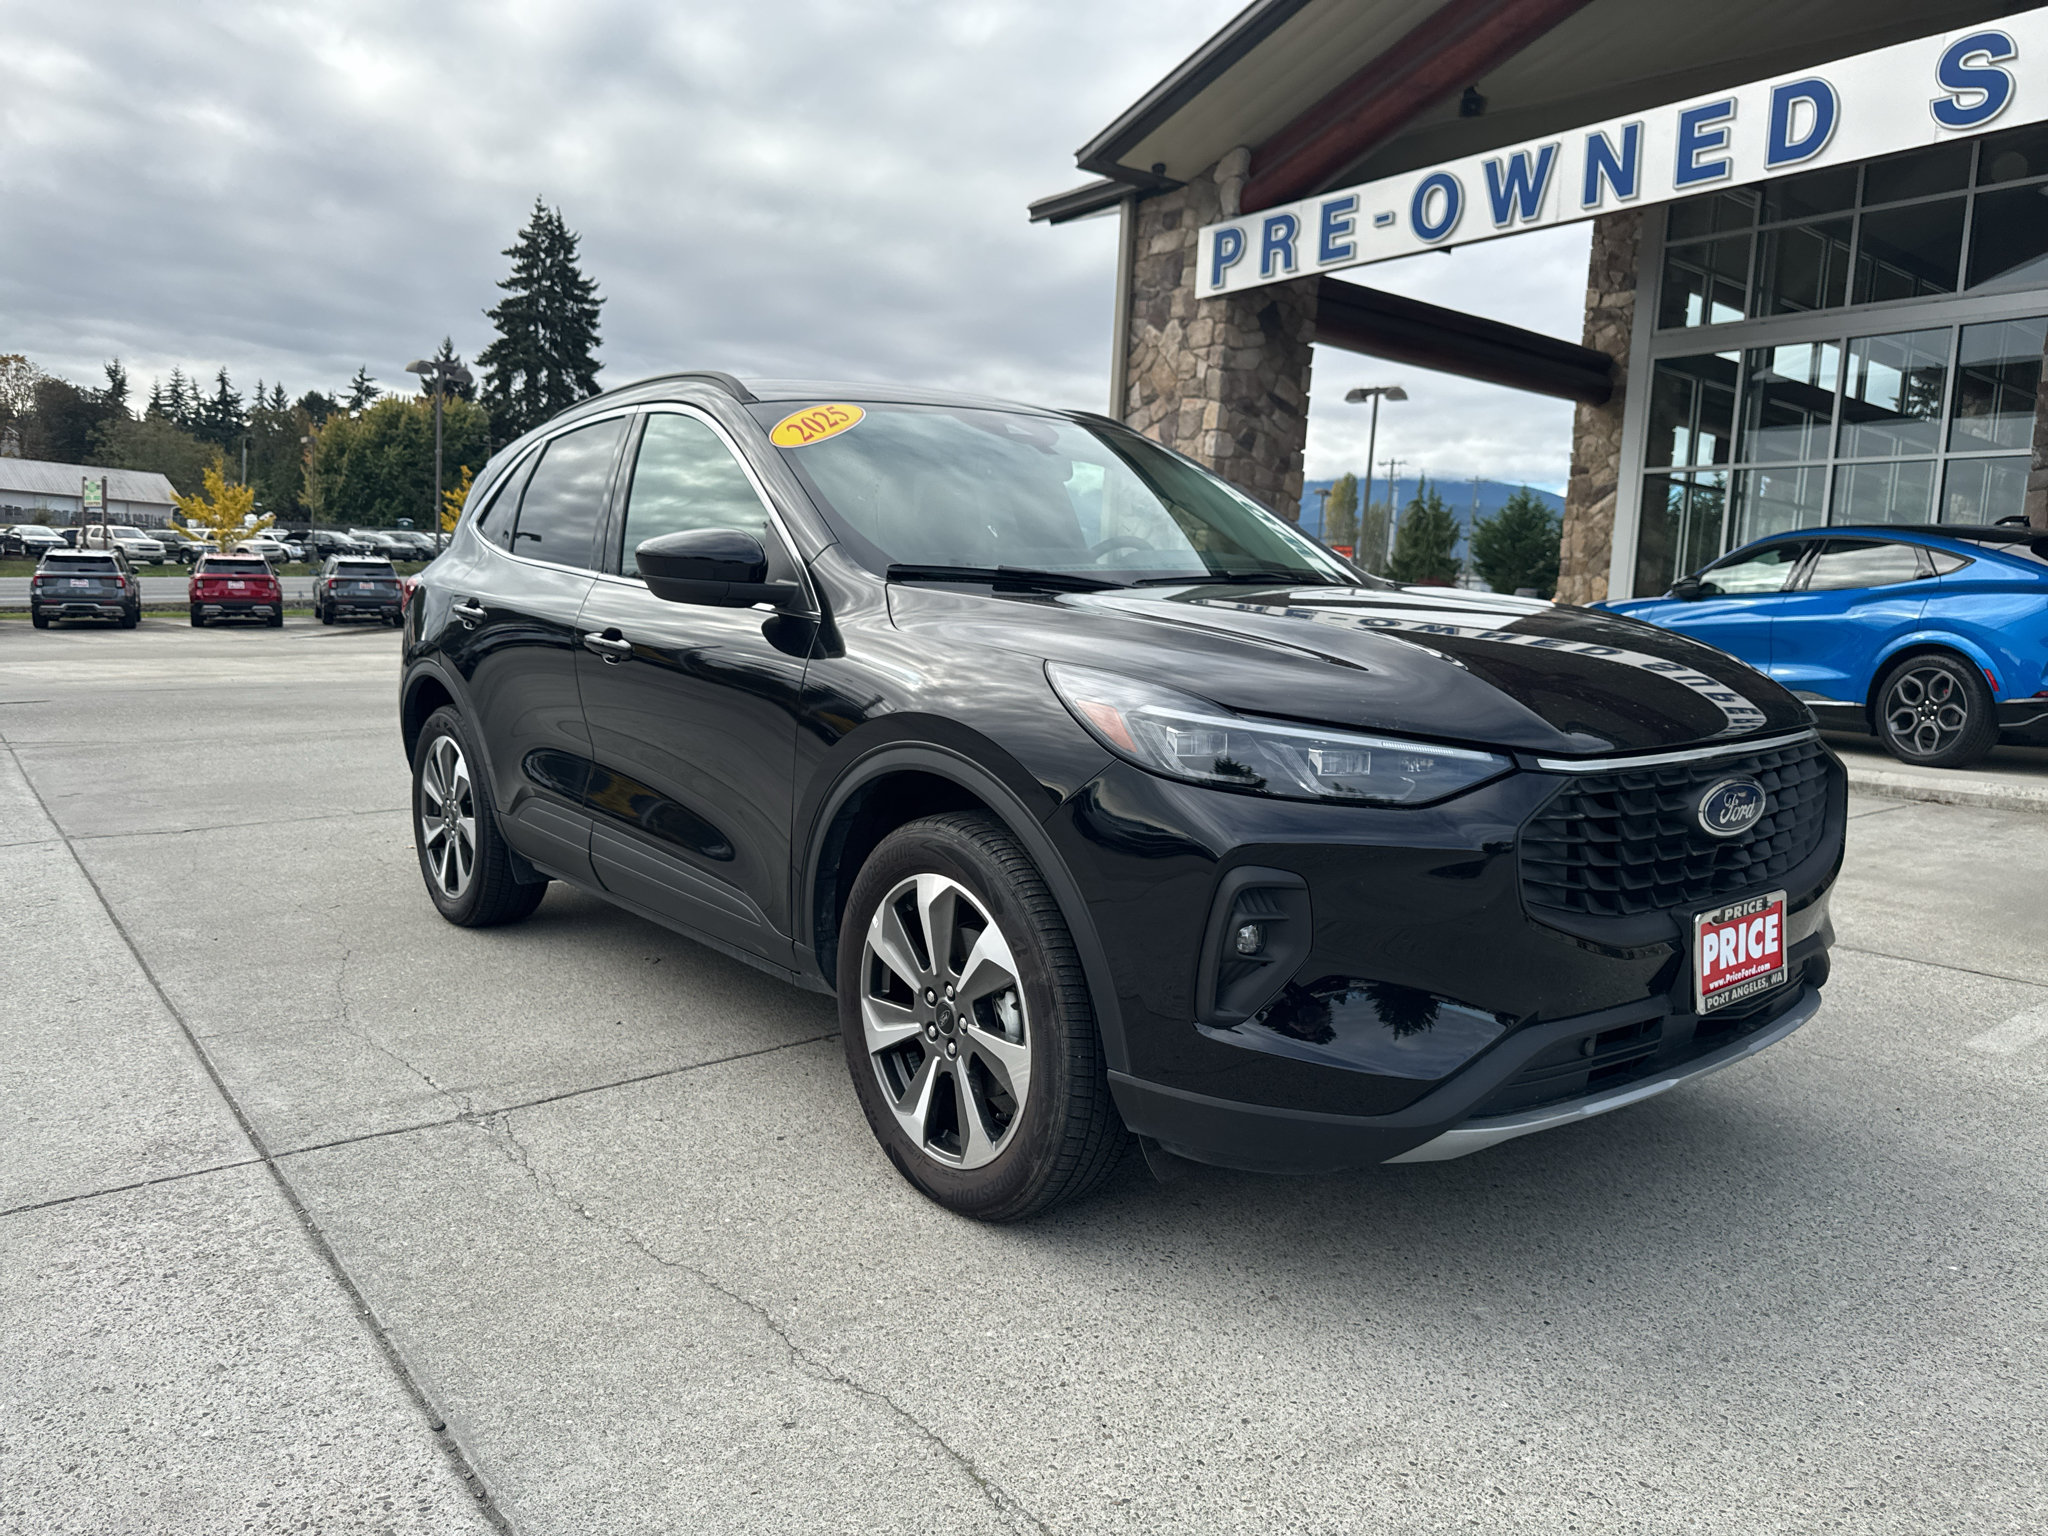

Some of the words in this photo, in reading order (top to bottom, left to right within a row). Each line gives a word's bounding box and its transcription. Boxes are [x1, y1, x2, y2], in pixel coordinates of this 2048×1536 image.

[1211, 75, 1842, 290] PRE-OWNED
[1929, 29, 2018, 131] S
[786, 406, 849, 442] 2025
[1720, 792, 1756, 824] Ford
[1724, 899, 1764, 921] PRICE
[1703, 913, 1778, 976] PRICE
[1707, 991, 1730, 1009] PORT
[1731, 977, 1769, 1000] ANGELES,
[1771, 972, 1783, 984] WA
[1709, 963, 1771, 990] www.PriceFord.com
